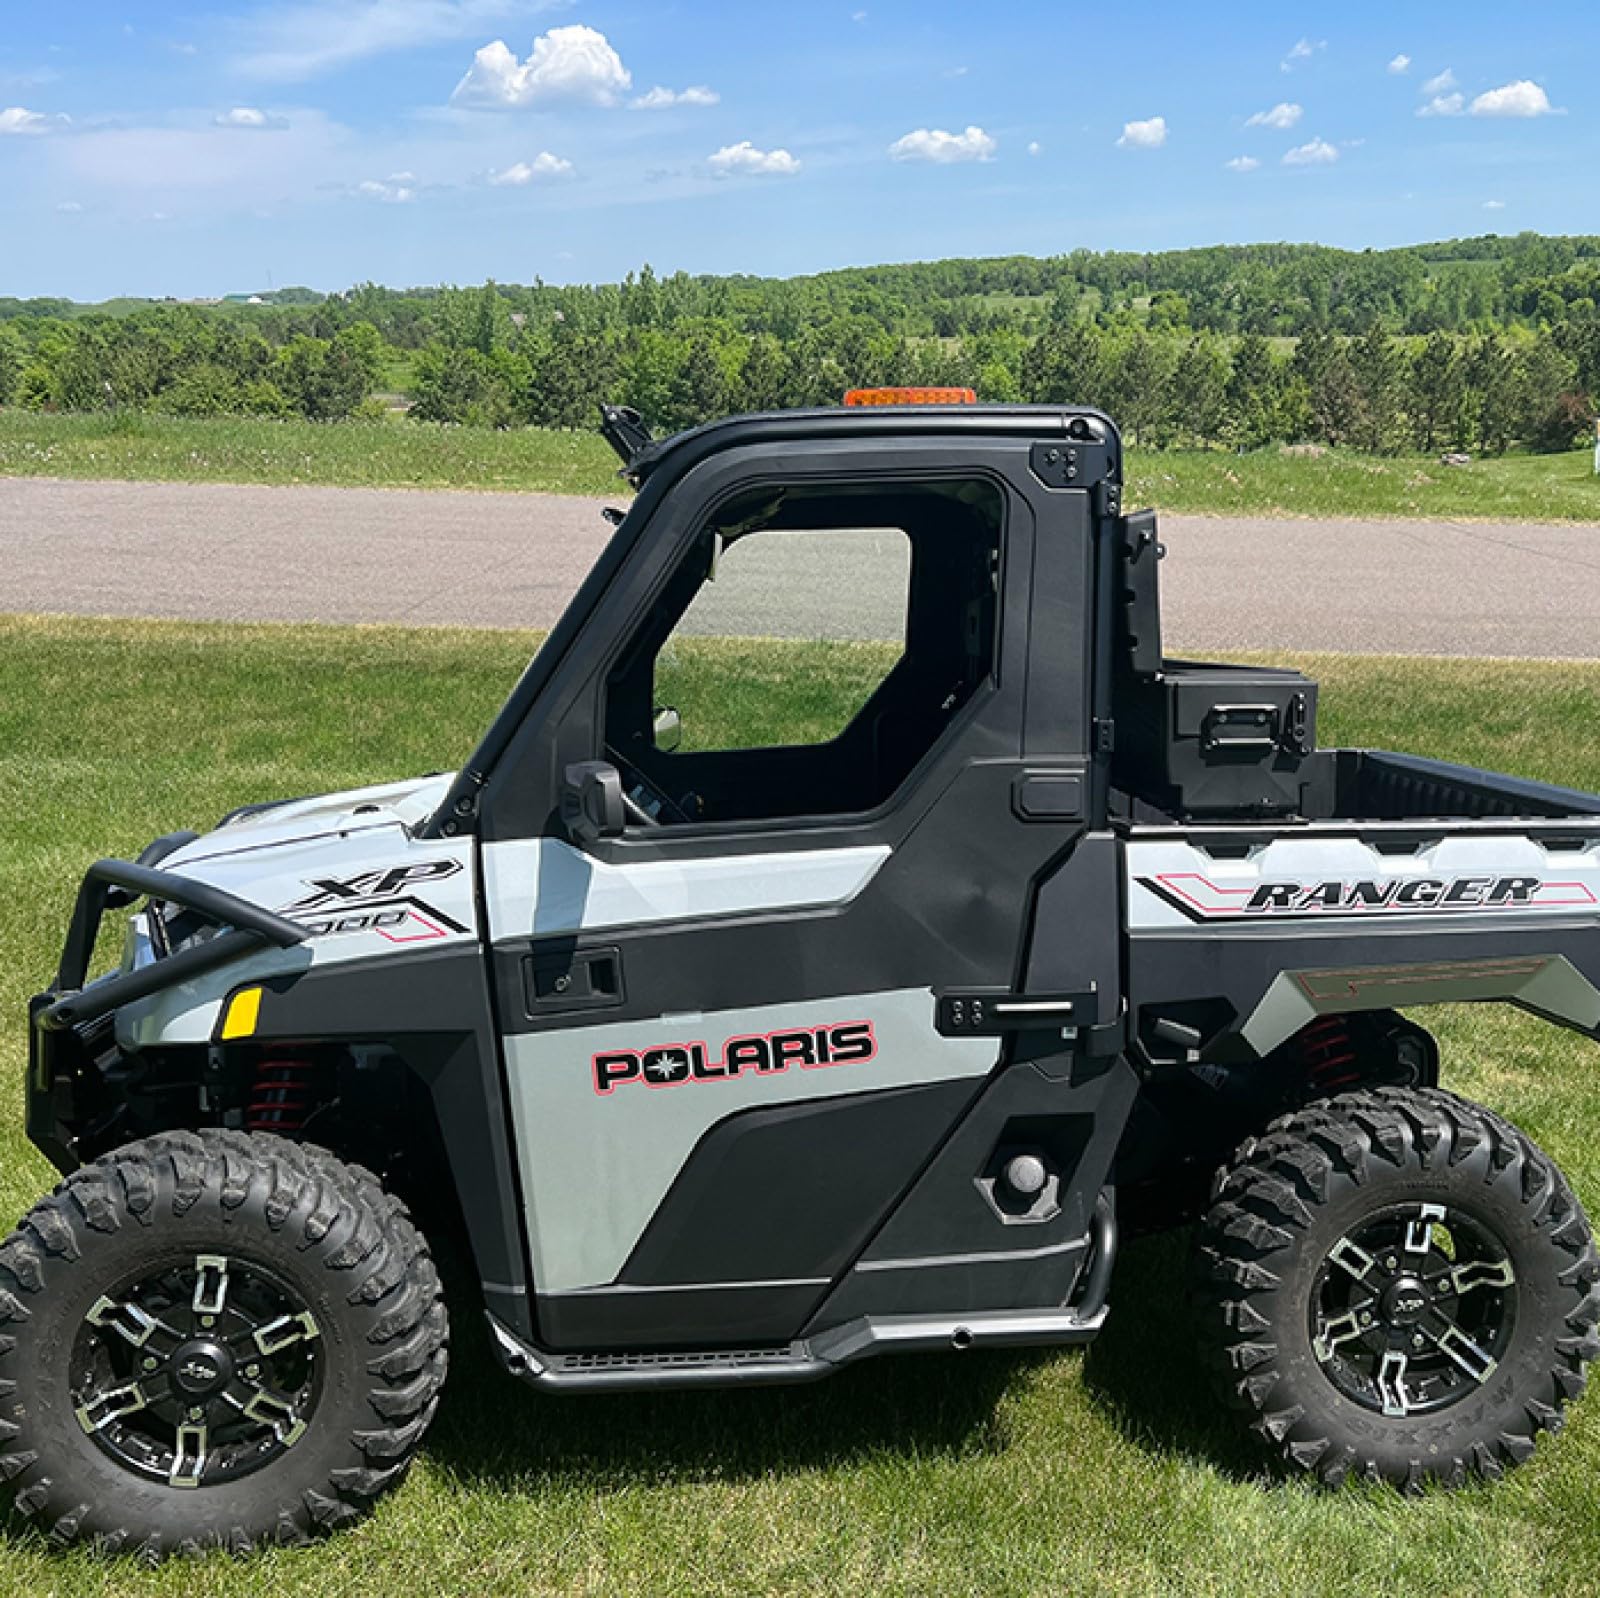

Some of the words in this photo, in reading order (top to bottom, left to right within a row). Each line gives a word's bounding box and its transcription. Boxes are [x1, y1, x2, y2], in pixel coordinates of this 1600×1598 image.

[280, 857, 464, 910] XP
[1244, 875, 1542, 913] RANGER
[592, 1020, 877, 1096] POLARIS
